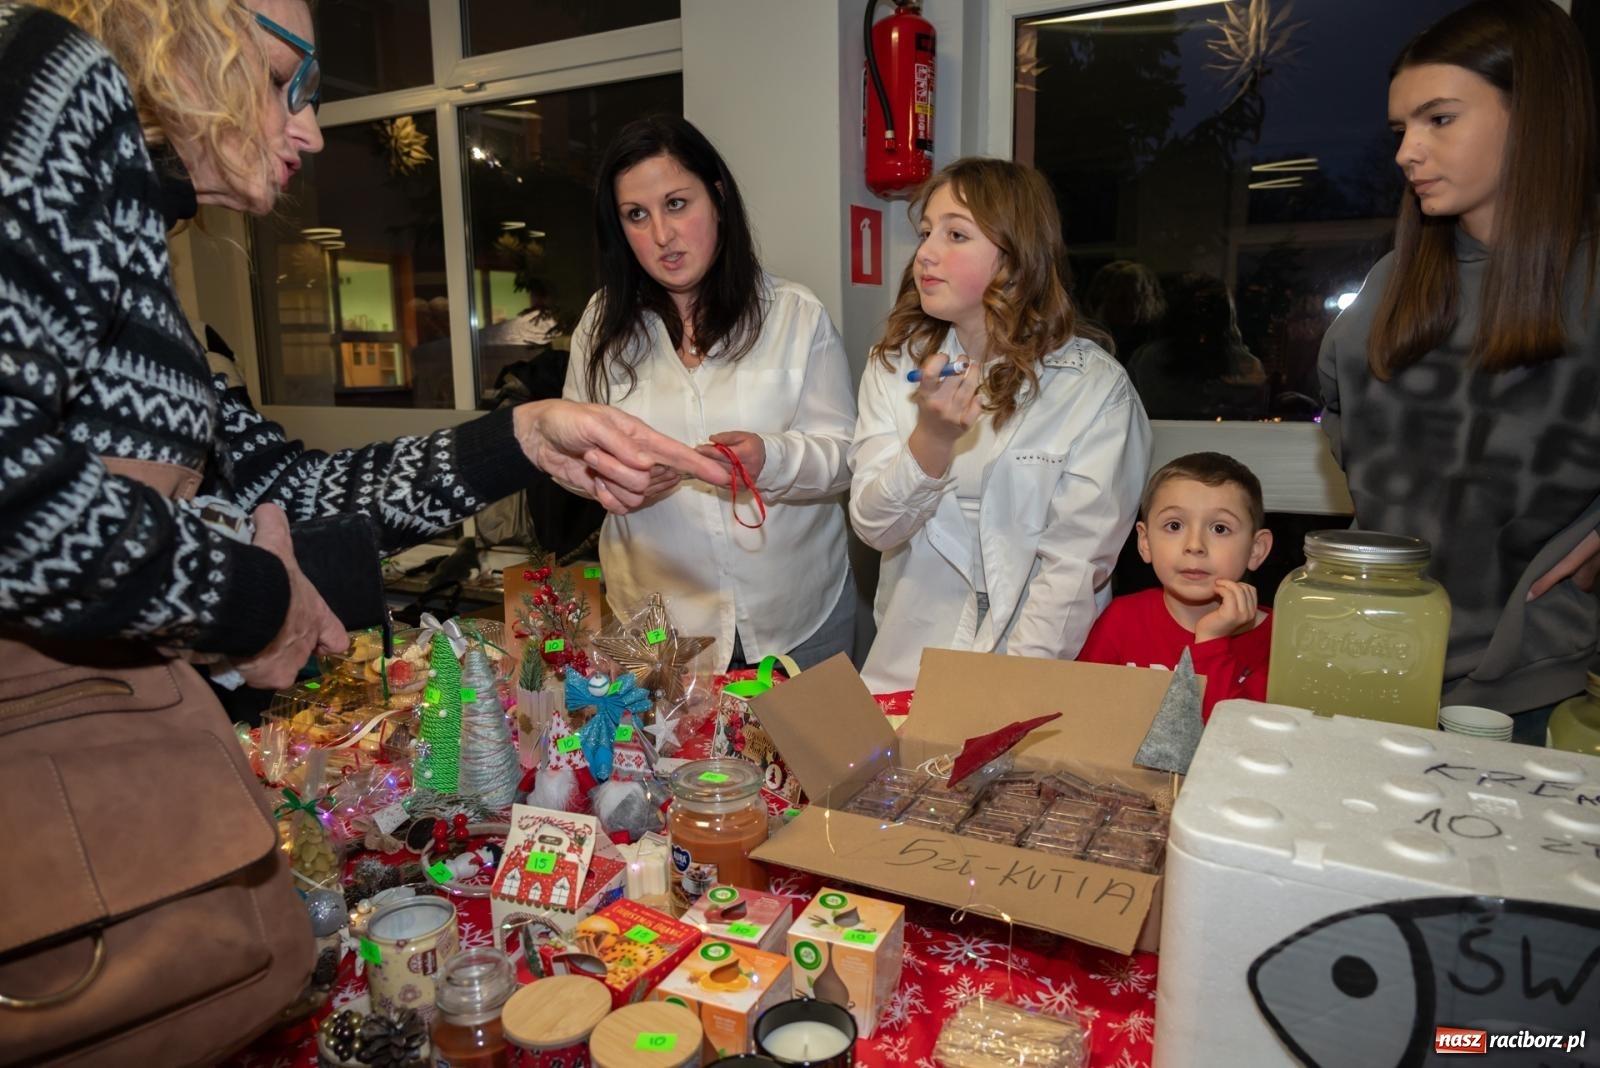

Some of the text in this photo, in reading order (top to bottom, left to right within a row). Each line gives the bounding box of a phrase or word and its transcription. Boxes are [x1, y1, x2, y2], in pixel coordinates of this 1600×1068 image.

[548, 641, 559, 651] 10
[563, 738, 574, 749] 10
[1414, 808, 1503, 839] 10
[534, 857, 547, 870] 15
[633, 929, 650, 939] 15
[850, 933, 866, 941] 10
[649, 1036, 667, 1047] 10
